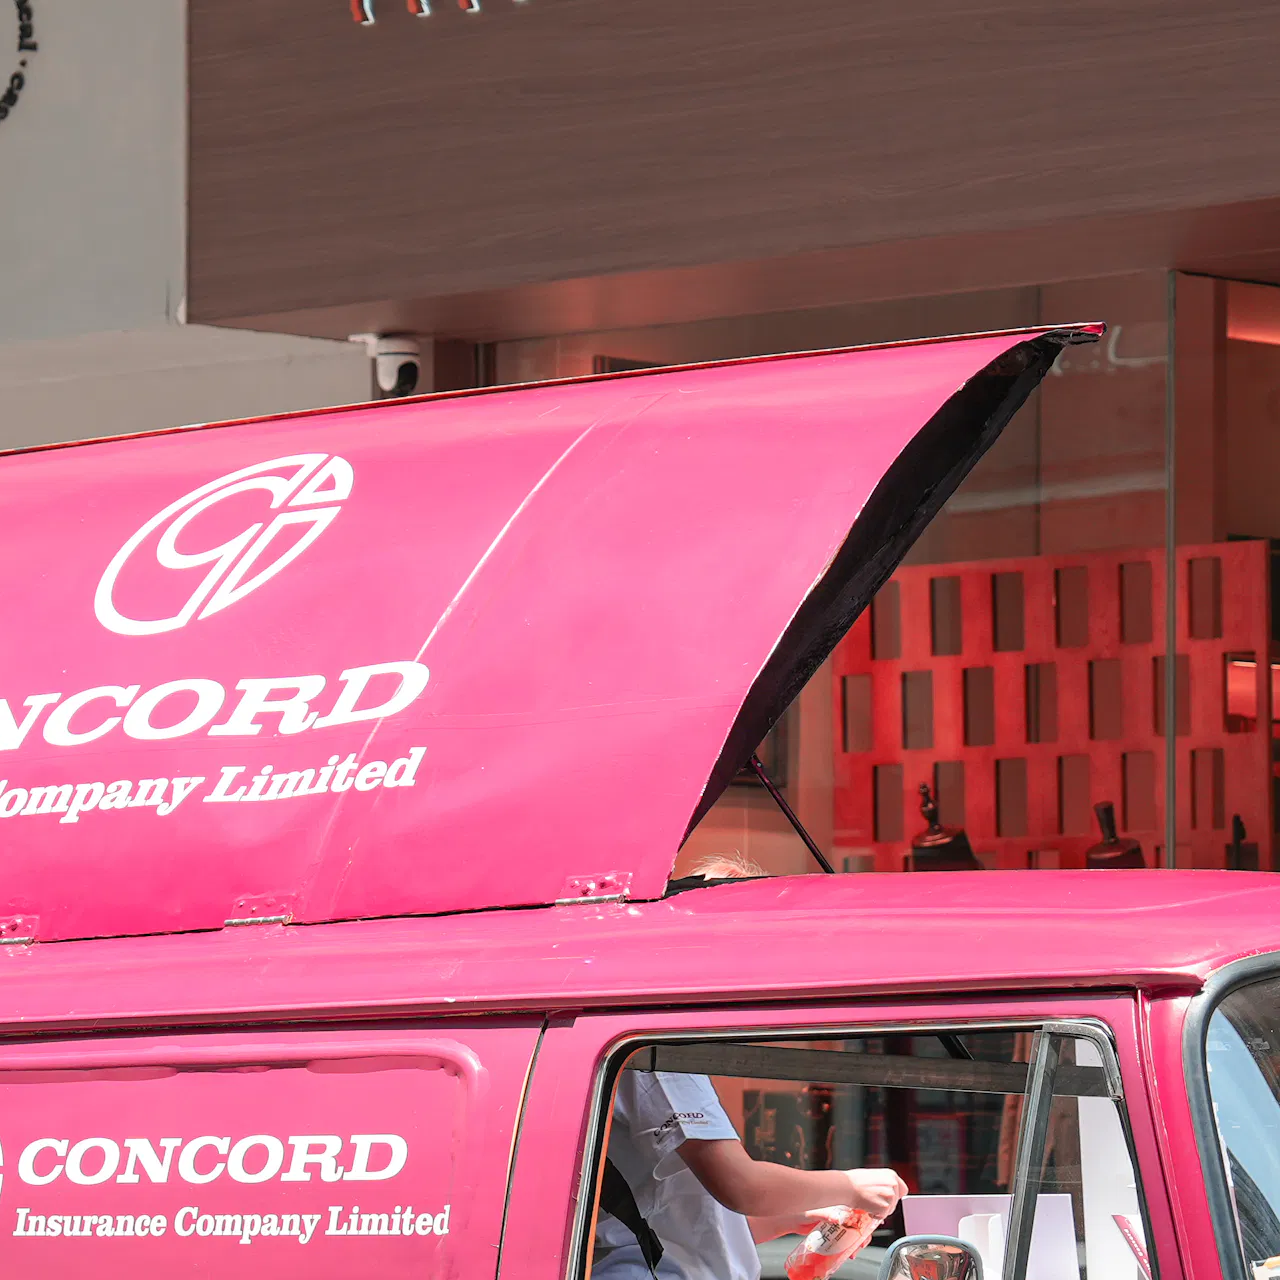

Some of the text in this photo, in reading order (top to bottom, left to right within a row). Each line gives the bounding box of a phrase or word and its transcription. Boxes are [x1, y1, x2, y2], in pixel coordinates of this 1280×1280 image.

[202, 747, 427, 803] Limited
[653, 1112, 704, 1137] CONCORD
[17, 1134, 409, 1187] CONCORD
[12, 1204, 452, 1245] Insurance Company Limited
